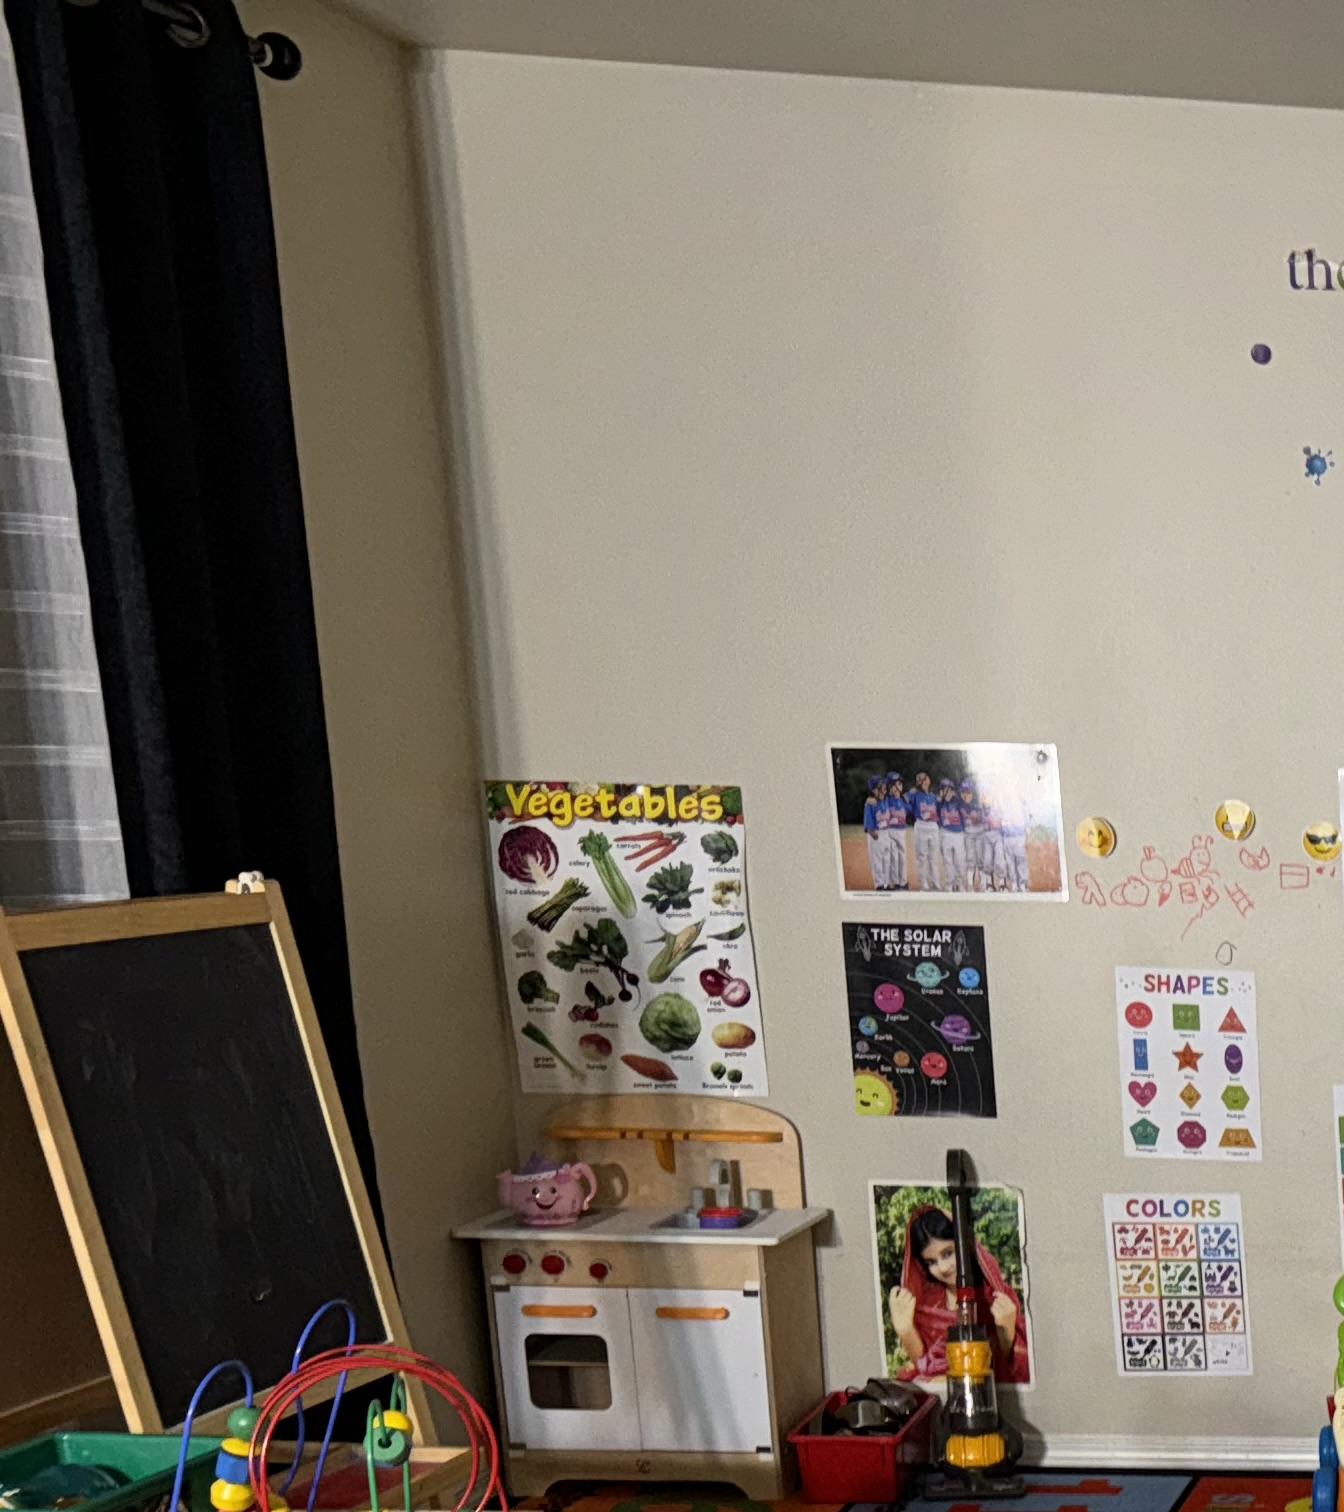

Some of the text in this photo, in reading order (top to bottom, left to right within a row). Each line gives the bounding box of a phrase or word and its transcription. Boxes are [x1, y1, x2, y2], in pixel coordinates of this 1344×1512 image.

[505, 783, 724, 827] Vegetables
[871, 928, 951, 943] THE SOLAR
[884, 944, 942, 958] SYSTEM
[1144, 974, 1229, 995] SHAPES
[1126, 1198, 1221, 1218] COLORS
